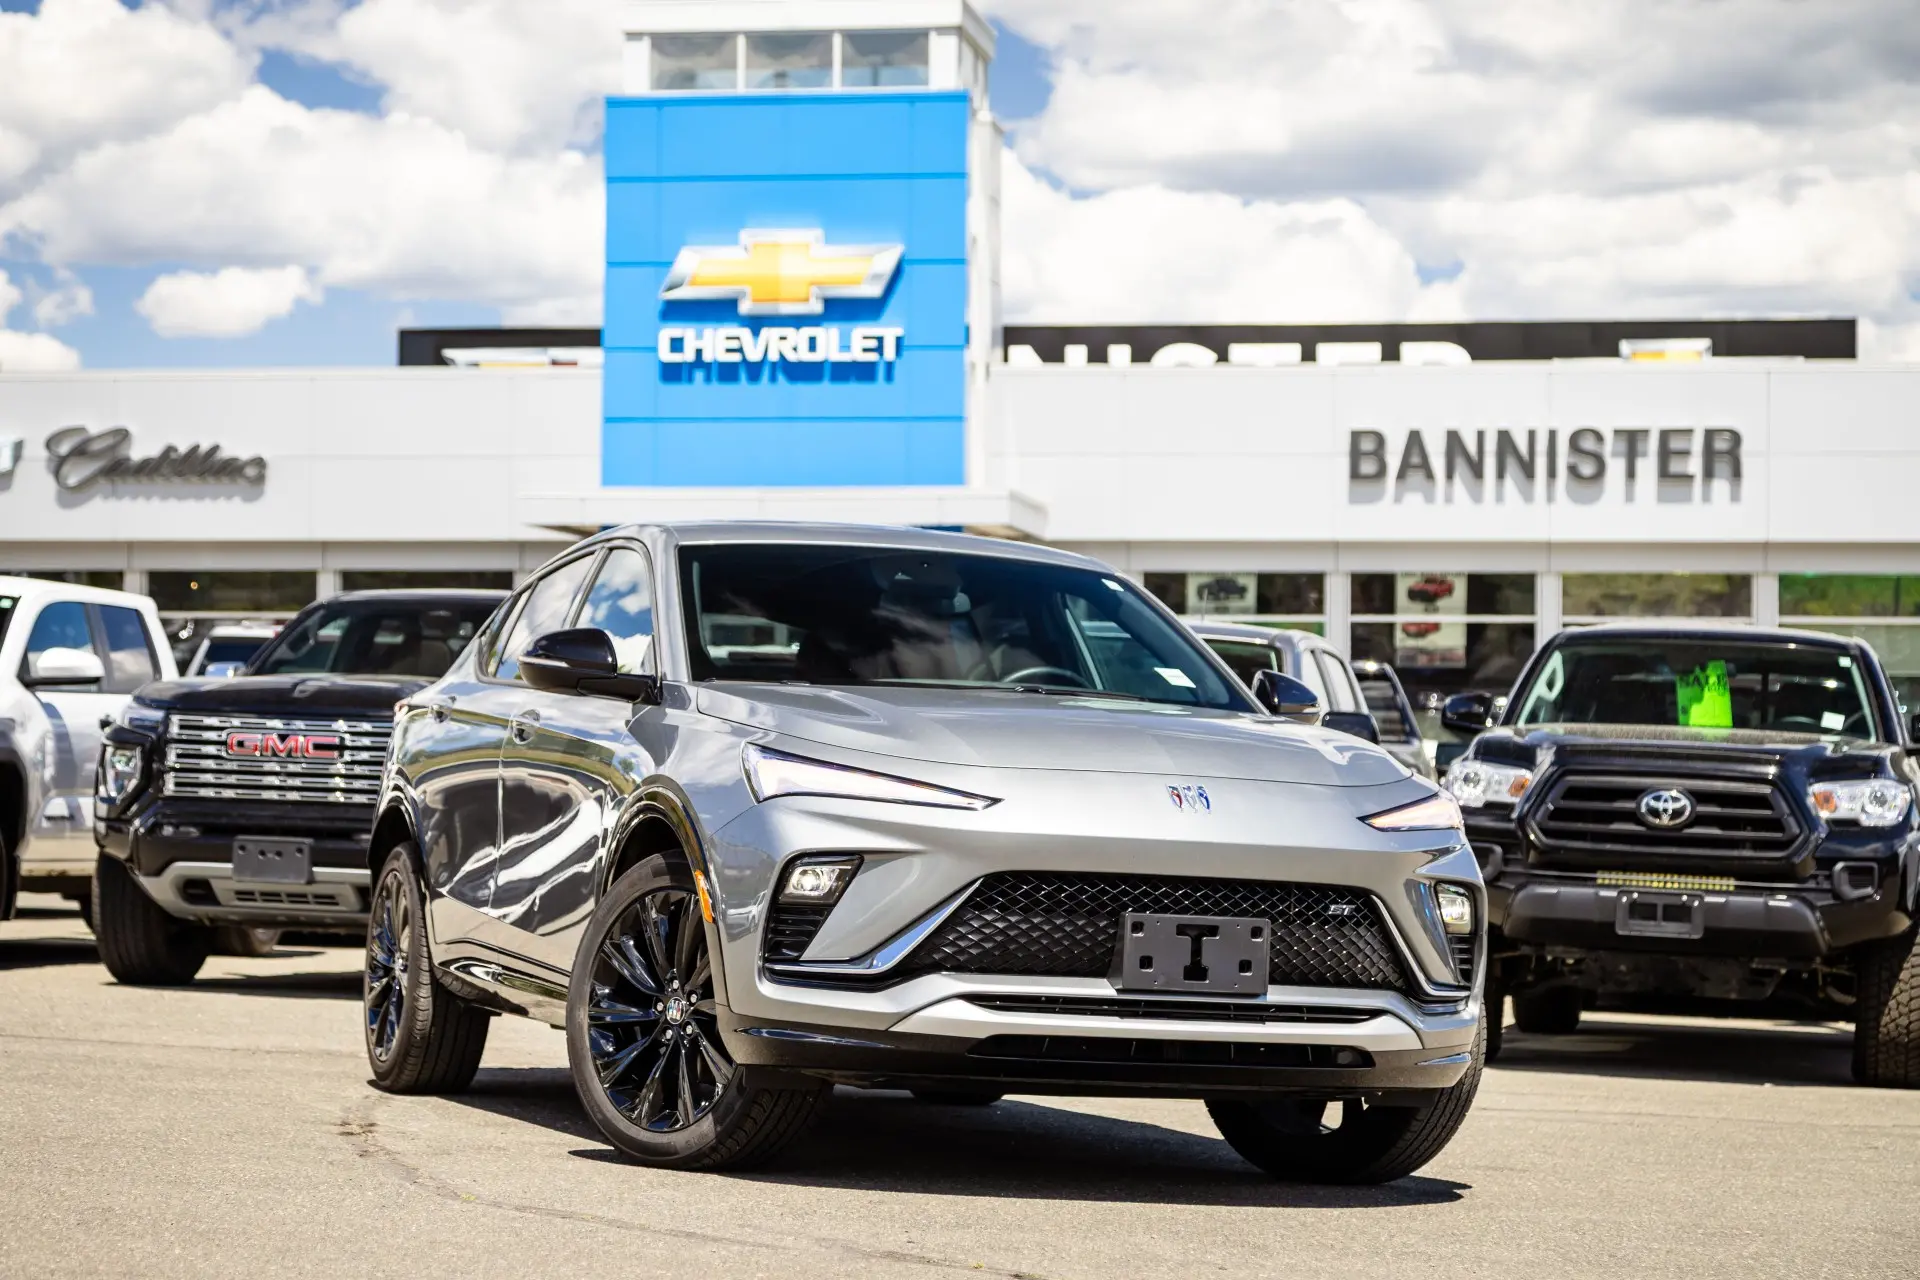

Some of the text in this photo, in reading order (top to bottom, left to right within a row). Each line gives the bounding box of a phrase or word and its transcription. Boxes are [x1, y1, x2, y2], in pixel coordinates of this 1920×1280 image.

[658, 326, 905, 363] CHEVROLET
[45, 424, 267, 490] Cadillac
[1349, 427, 1743, 480] BANNISTER
[226, 732, 340, 759] GMC
[1329, 904, 1356, 915] ST
